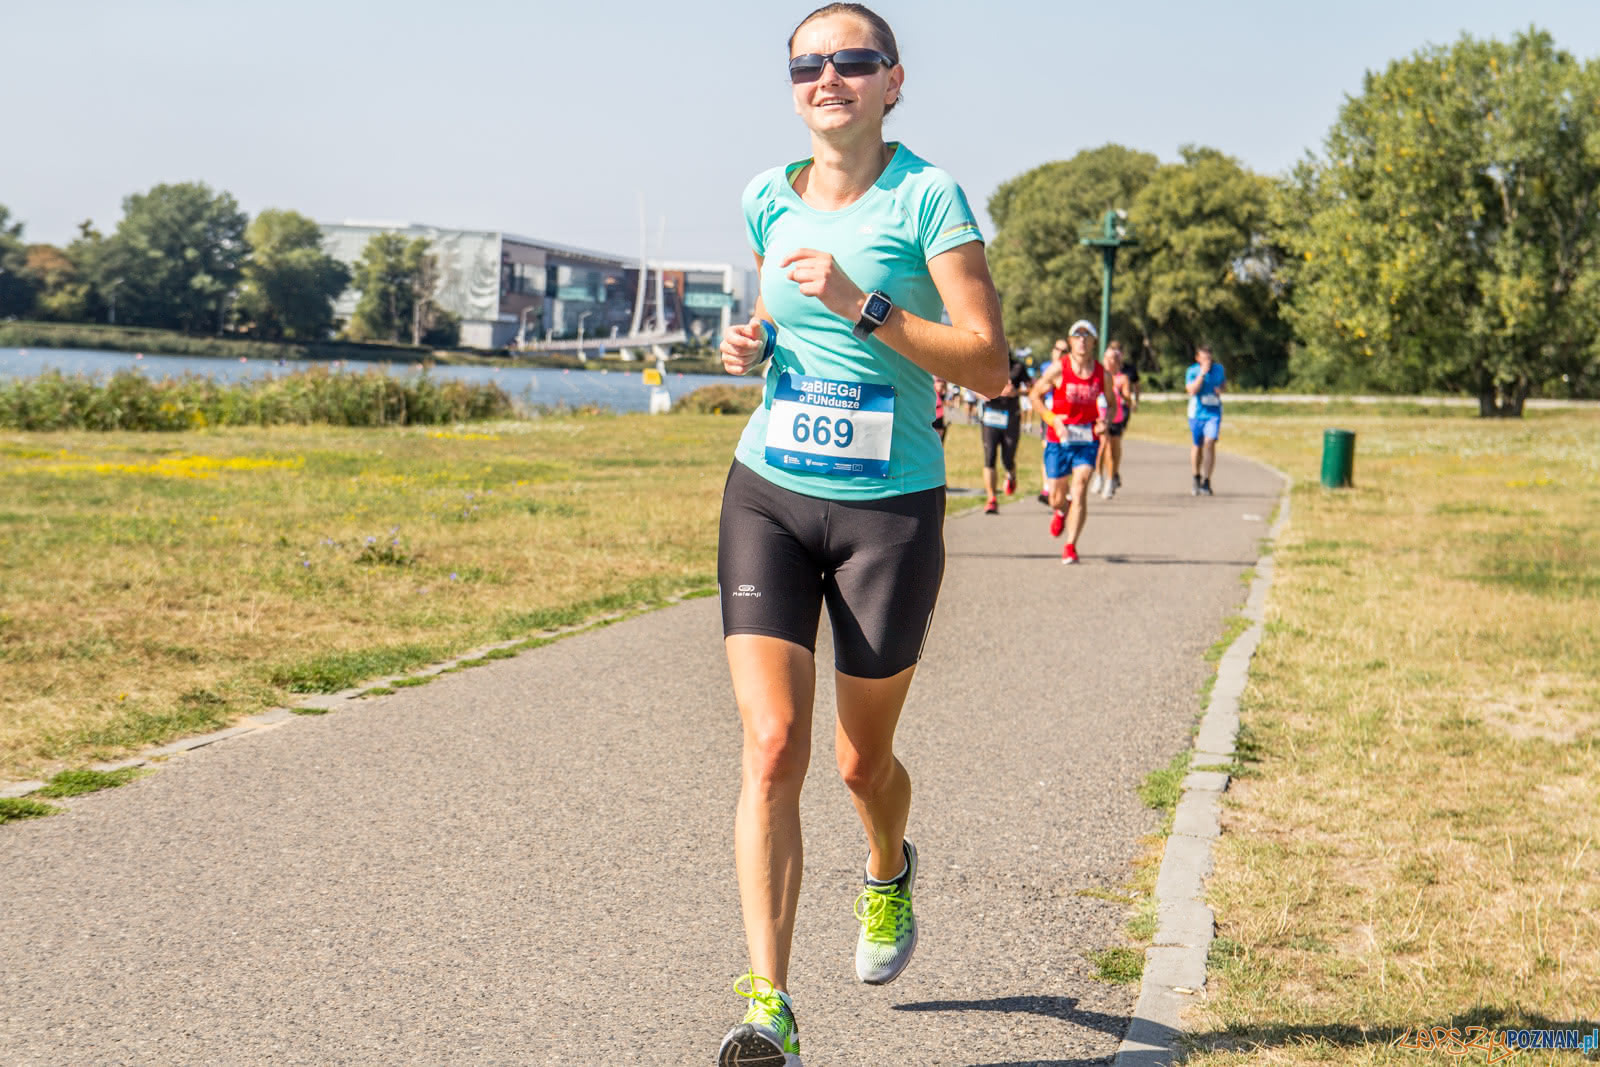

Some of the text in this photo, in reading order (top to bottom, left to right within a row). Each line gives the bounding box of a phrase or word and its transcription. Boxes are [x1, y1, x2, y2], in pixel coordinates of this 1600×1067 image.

[801, 381, 862, 400] zaBIEGaj
[807, 395, 860, 409] FUNdusze
[793, 413, 854, 448] 669
